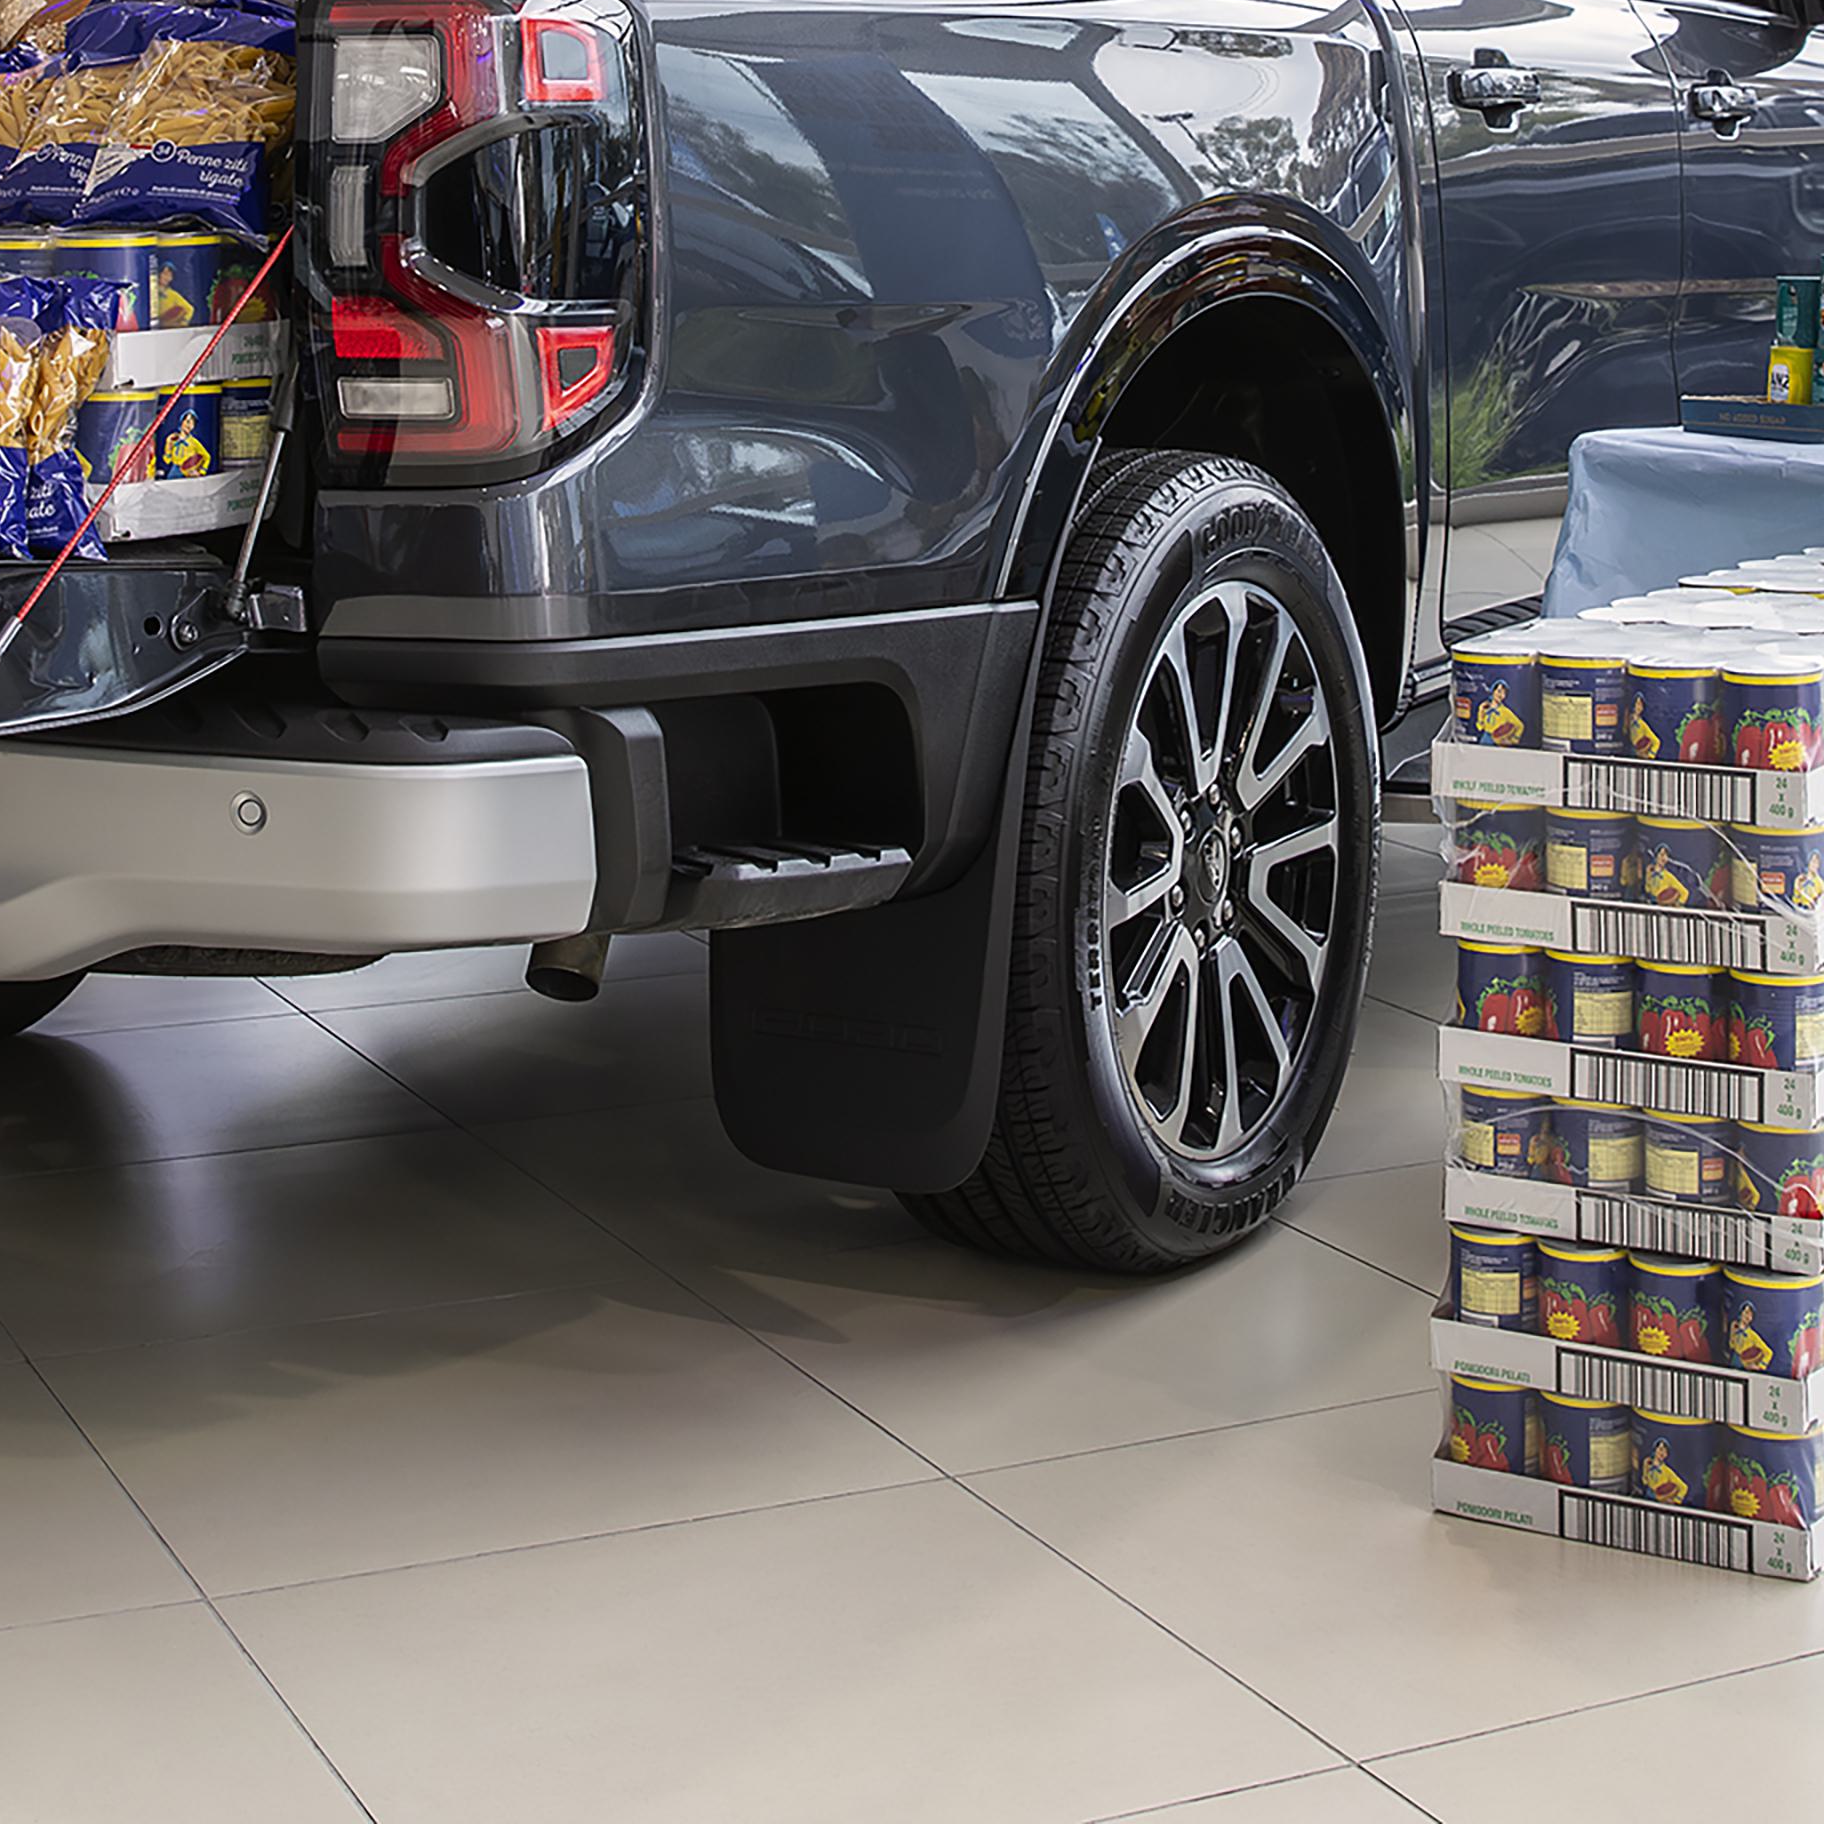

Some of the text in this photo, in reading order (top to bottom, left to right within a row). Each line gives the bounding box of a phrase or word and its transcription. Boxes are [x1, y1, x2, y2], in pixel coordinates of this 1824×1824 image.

[177, 149, 222, 168] Penne
[223, 152, 250, 173] ziti
[199, 169, 246, 189] rigate
[1776, 776, 1788, 789] 24
[1769, 804, 1786, 816] 400
[1460, 921, 1554, 942] WHOLE PEELED TOMATOES
[1785, 924, 1798, 937] 24
[1779, 951, 1796, 963] 400
[1458, 1064, 1552, 1089] WHOLE PEELED TOMATOES
[1783, 1077, 1797, 1090] 24
[1776, 1104, 1794, 1116] 400
[1454, 1360, 1532, 1384] POMODORI PELATI
[1768, 1384, 1781, 1398] 24
[1762, 1411, 1780, 1424] 400
[1456, 1500, 1533, 1526] POMODORI PELATI
[1773, 1531, 1786, 1544] 24
[1767, 1557, 1784, 1569] 400
